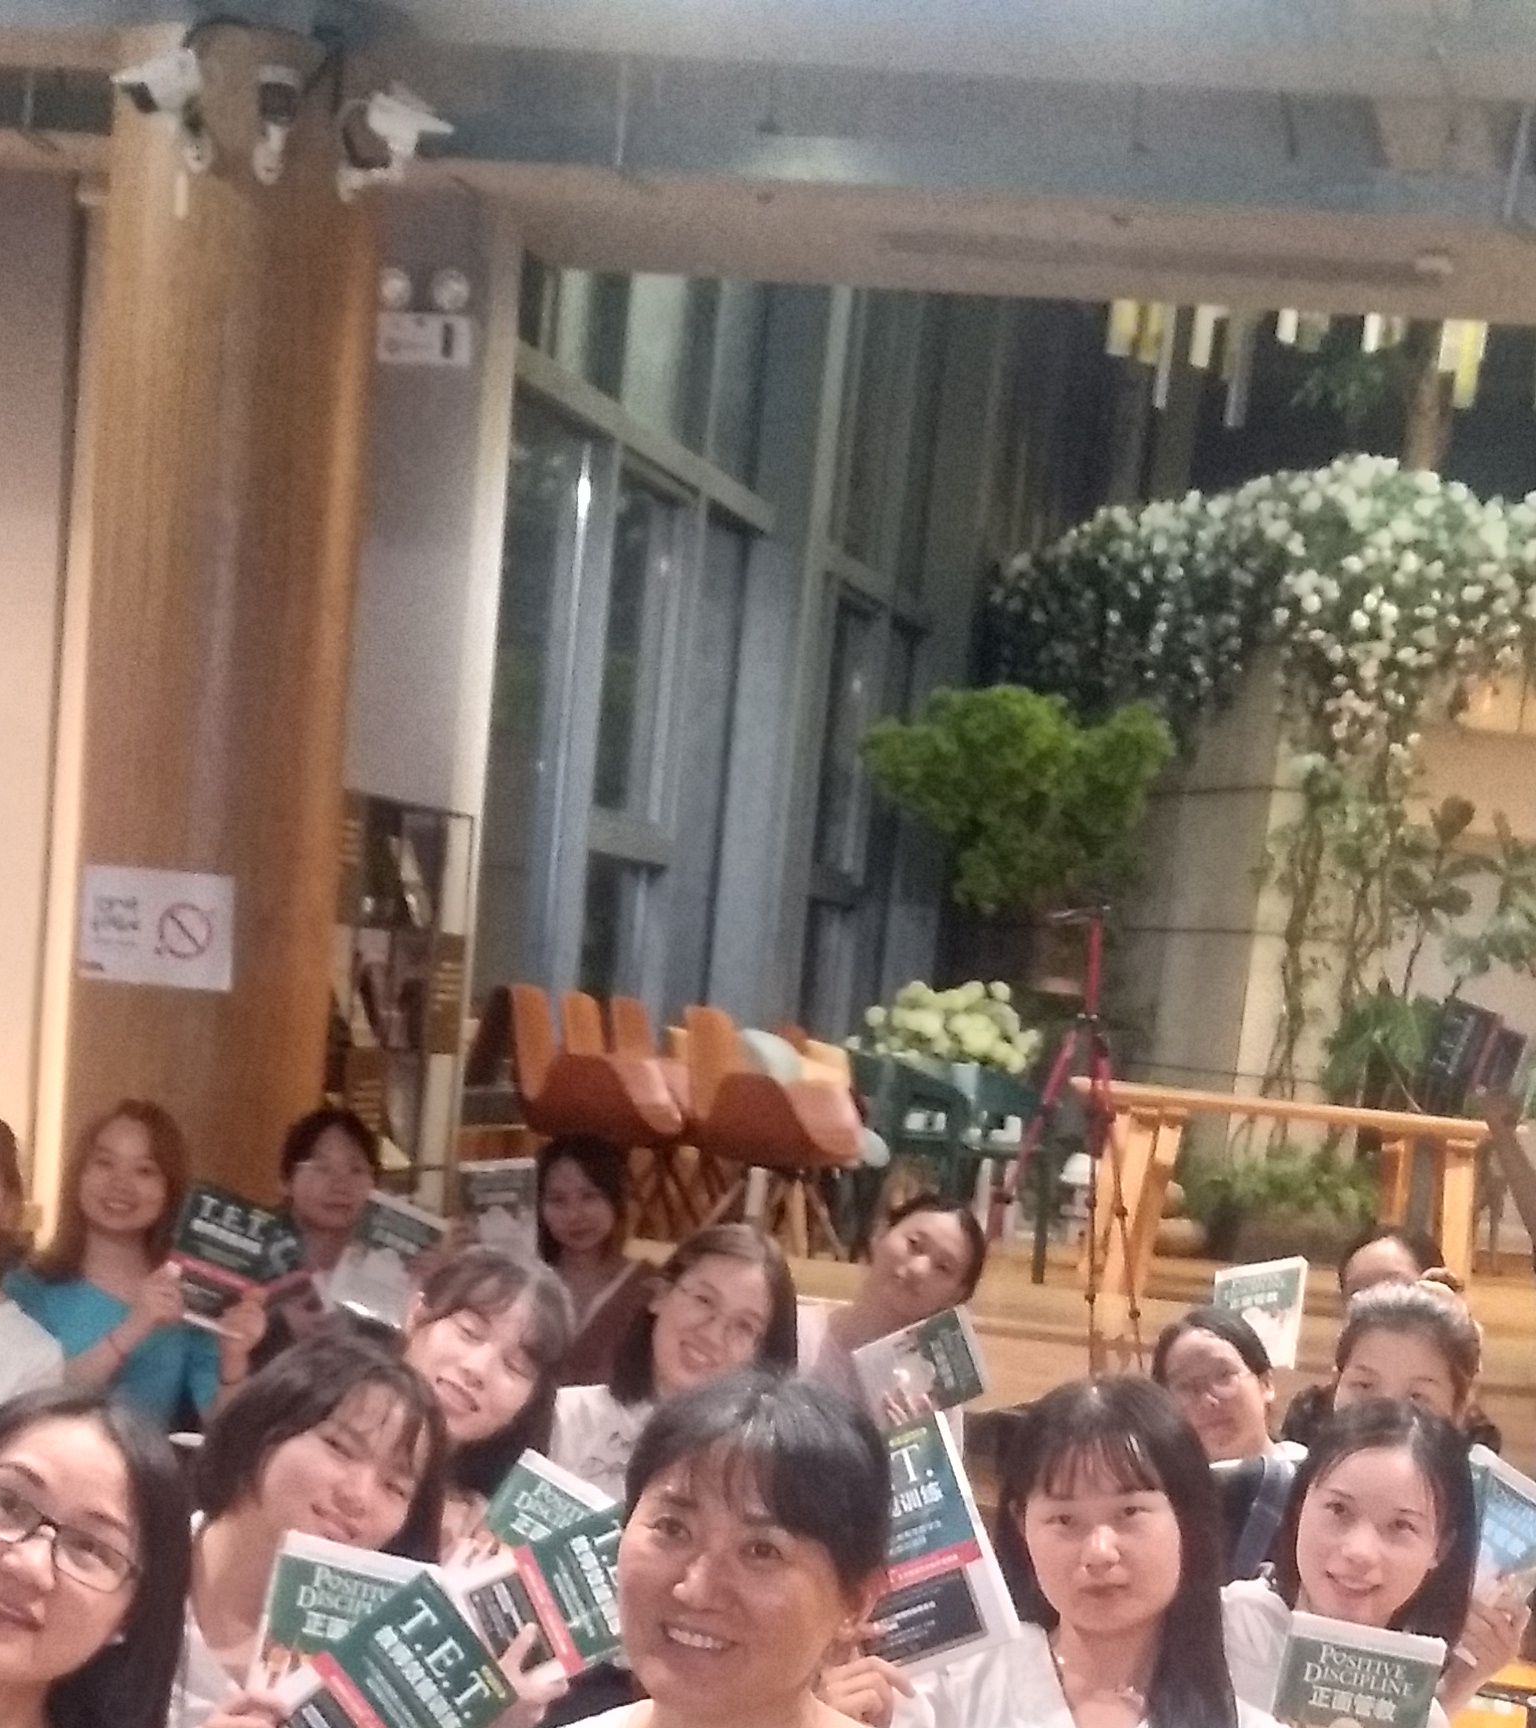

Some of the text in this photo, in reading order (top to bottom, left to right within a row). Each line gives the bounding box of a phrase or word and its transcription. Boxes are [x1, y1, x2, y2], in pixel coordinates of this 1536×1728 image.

[398, 1598, 492, 1720] T.E.T.
[1319, 1643, 1407, 1680] POSITIVE
[1303, 1661, 1414, 1697] DISCIPLINE
